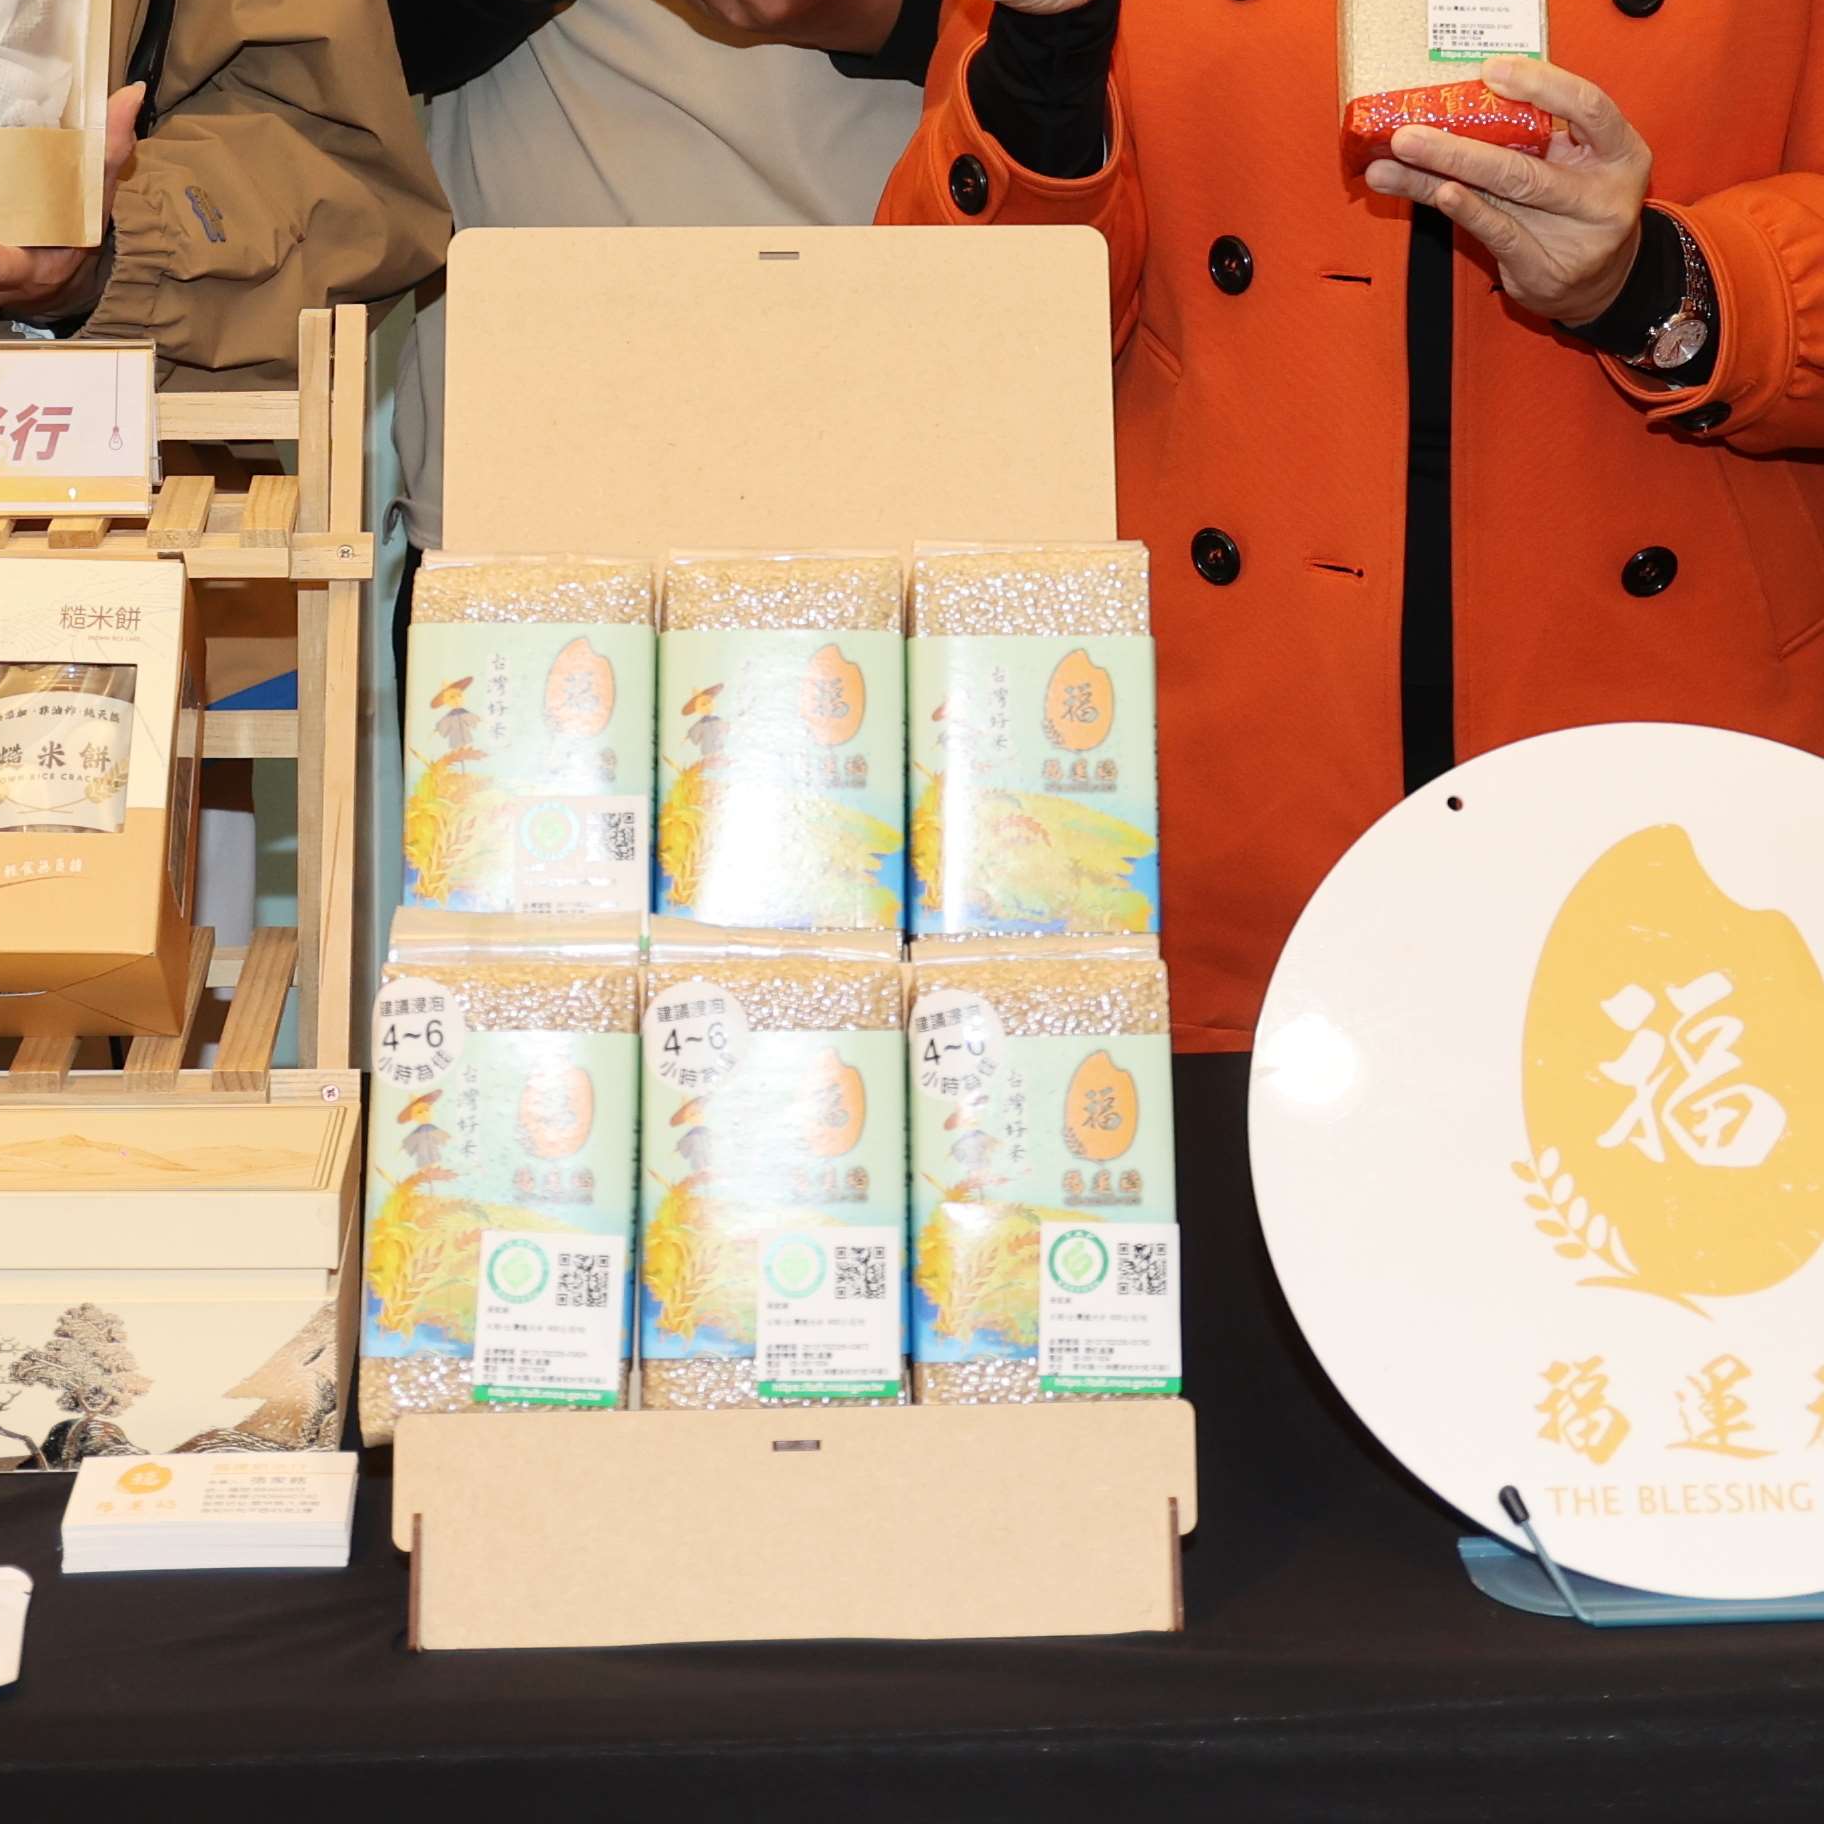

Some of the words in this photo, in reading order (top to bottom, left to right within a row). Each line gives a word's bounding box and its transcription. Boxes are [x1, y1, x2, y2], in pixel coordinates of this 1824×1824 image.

[59, 604, 142, 632] 糙米餅
[1062, 683, 1100, 723] 福
[380, 996, 445, 1017] 建議浸泡
[382, 1019, 444, 1052] 4~6
[664, 1022, 727, 1056] 4~6
[1595, 971, 1788, 1168] 福
[1082, 1087, 1122, 1131] 福
[1545, 1485, 1622, 1518] THE
[1638, 1482, 1814, 1516] BLESSING
